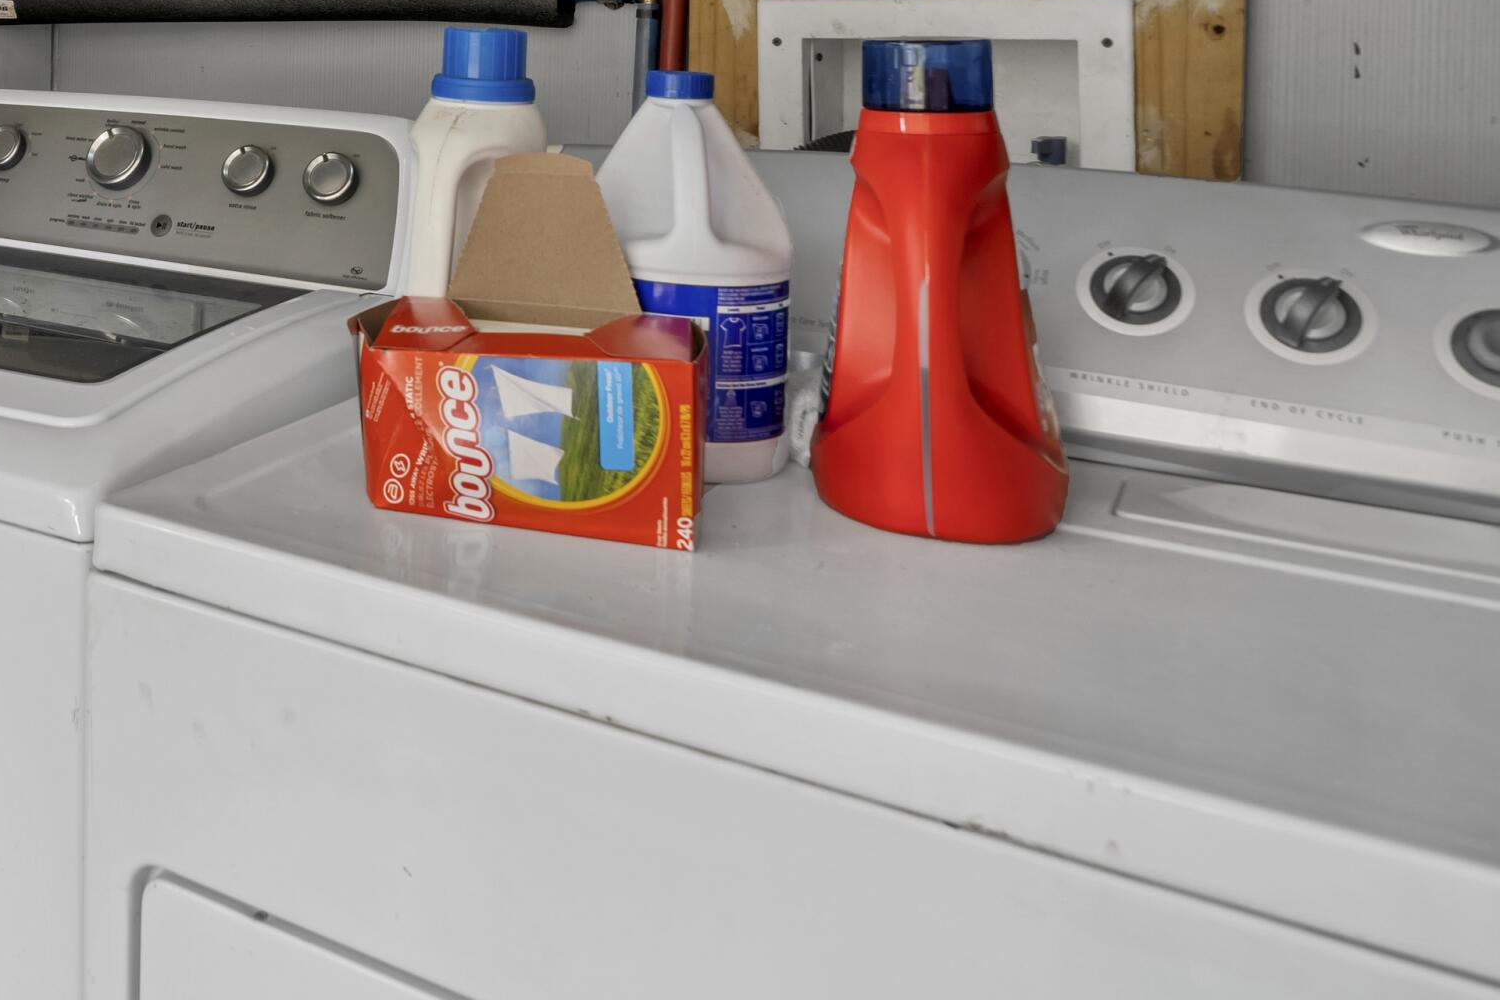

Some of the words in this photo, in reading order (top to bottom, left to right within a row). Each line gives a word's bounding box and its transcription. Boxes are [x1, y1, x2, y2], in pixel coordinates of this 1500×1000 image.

[176, 221, 215, 232] start/pause
[405, 376, 414, 410] STATIC
[1069, 371, 1130, 388] WRINKLE
[1139, 380, 1189, 397] SHIELD
[1250, 398, 1280, 411] END
[1288, 405, 1306, 415] OF
[1315, 409, 1363, 425] CYCLE
[437, 365, 494, 522] bounce
[676, 517, 694, 552] 240
